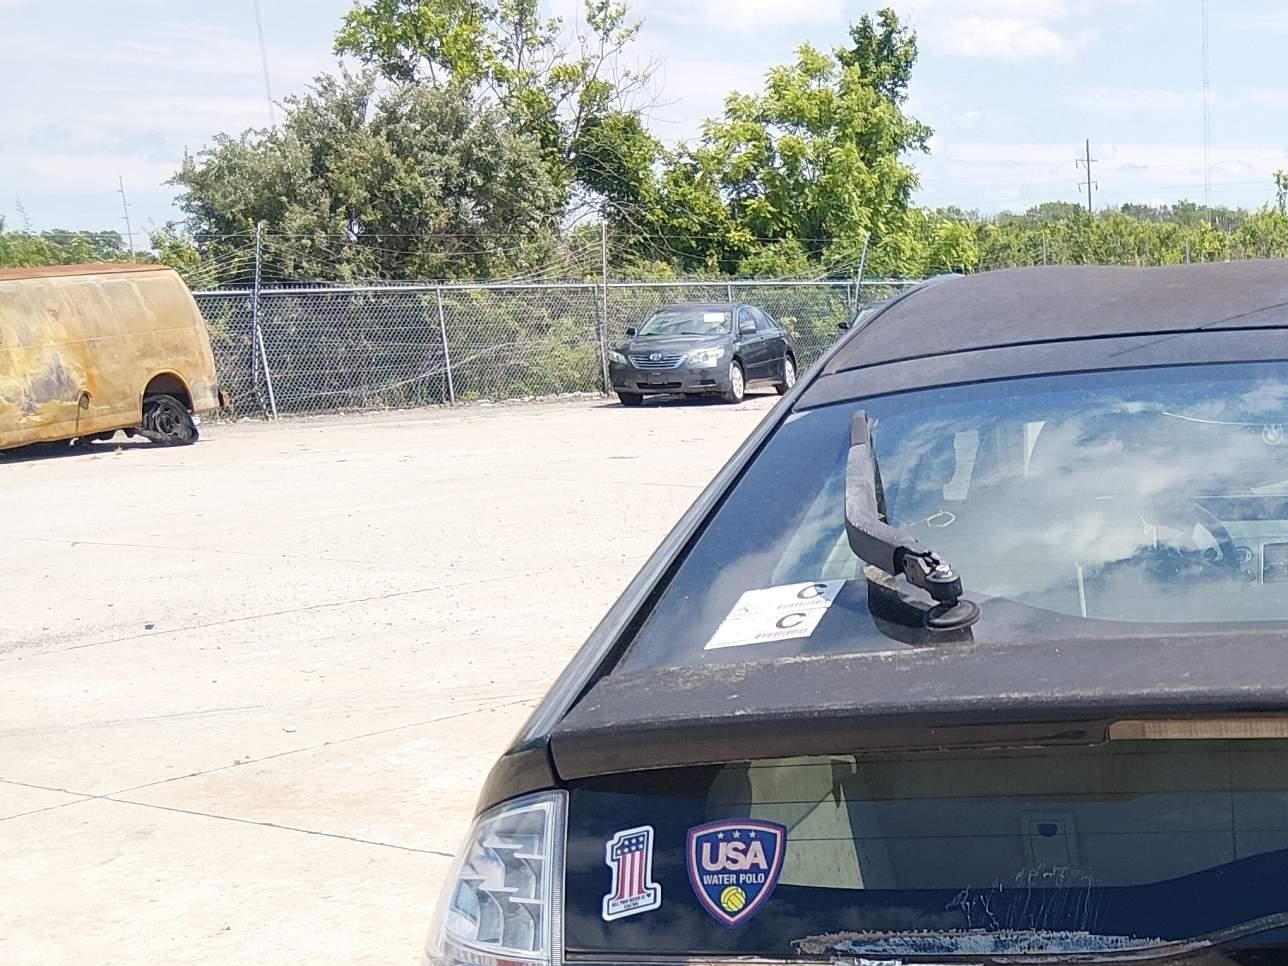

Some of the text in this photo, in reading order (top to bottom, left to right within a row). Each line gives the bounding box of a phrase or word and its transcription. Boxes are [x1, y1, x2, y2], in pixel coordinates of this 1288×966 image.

[776, 612, 807, 629] C
[701, 840, 768, 871] USA
[703, 872, 765, 885] WATER POLO
